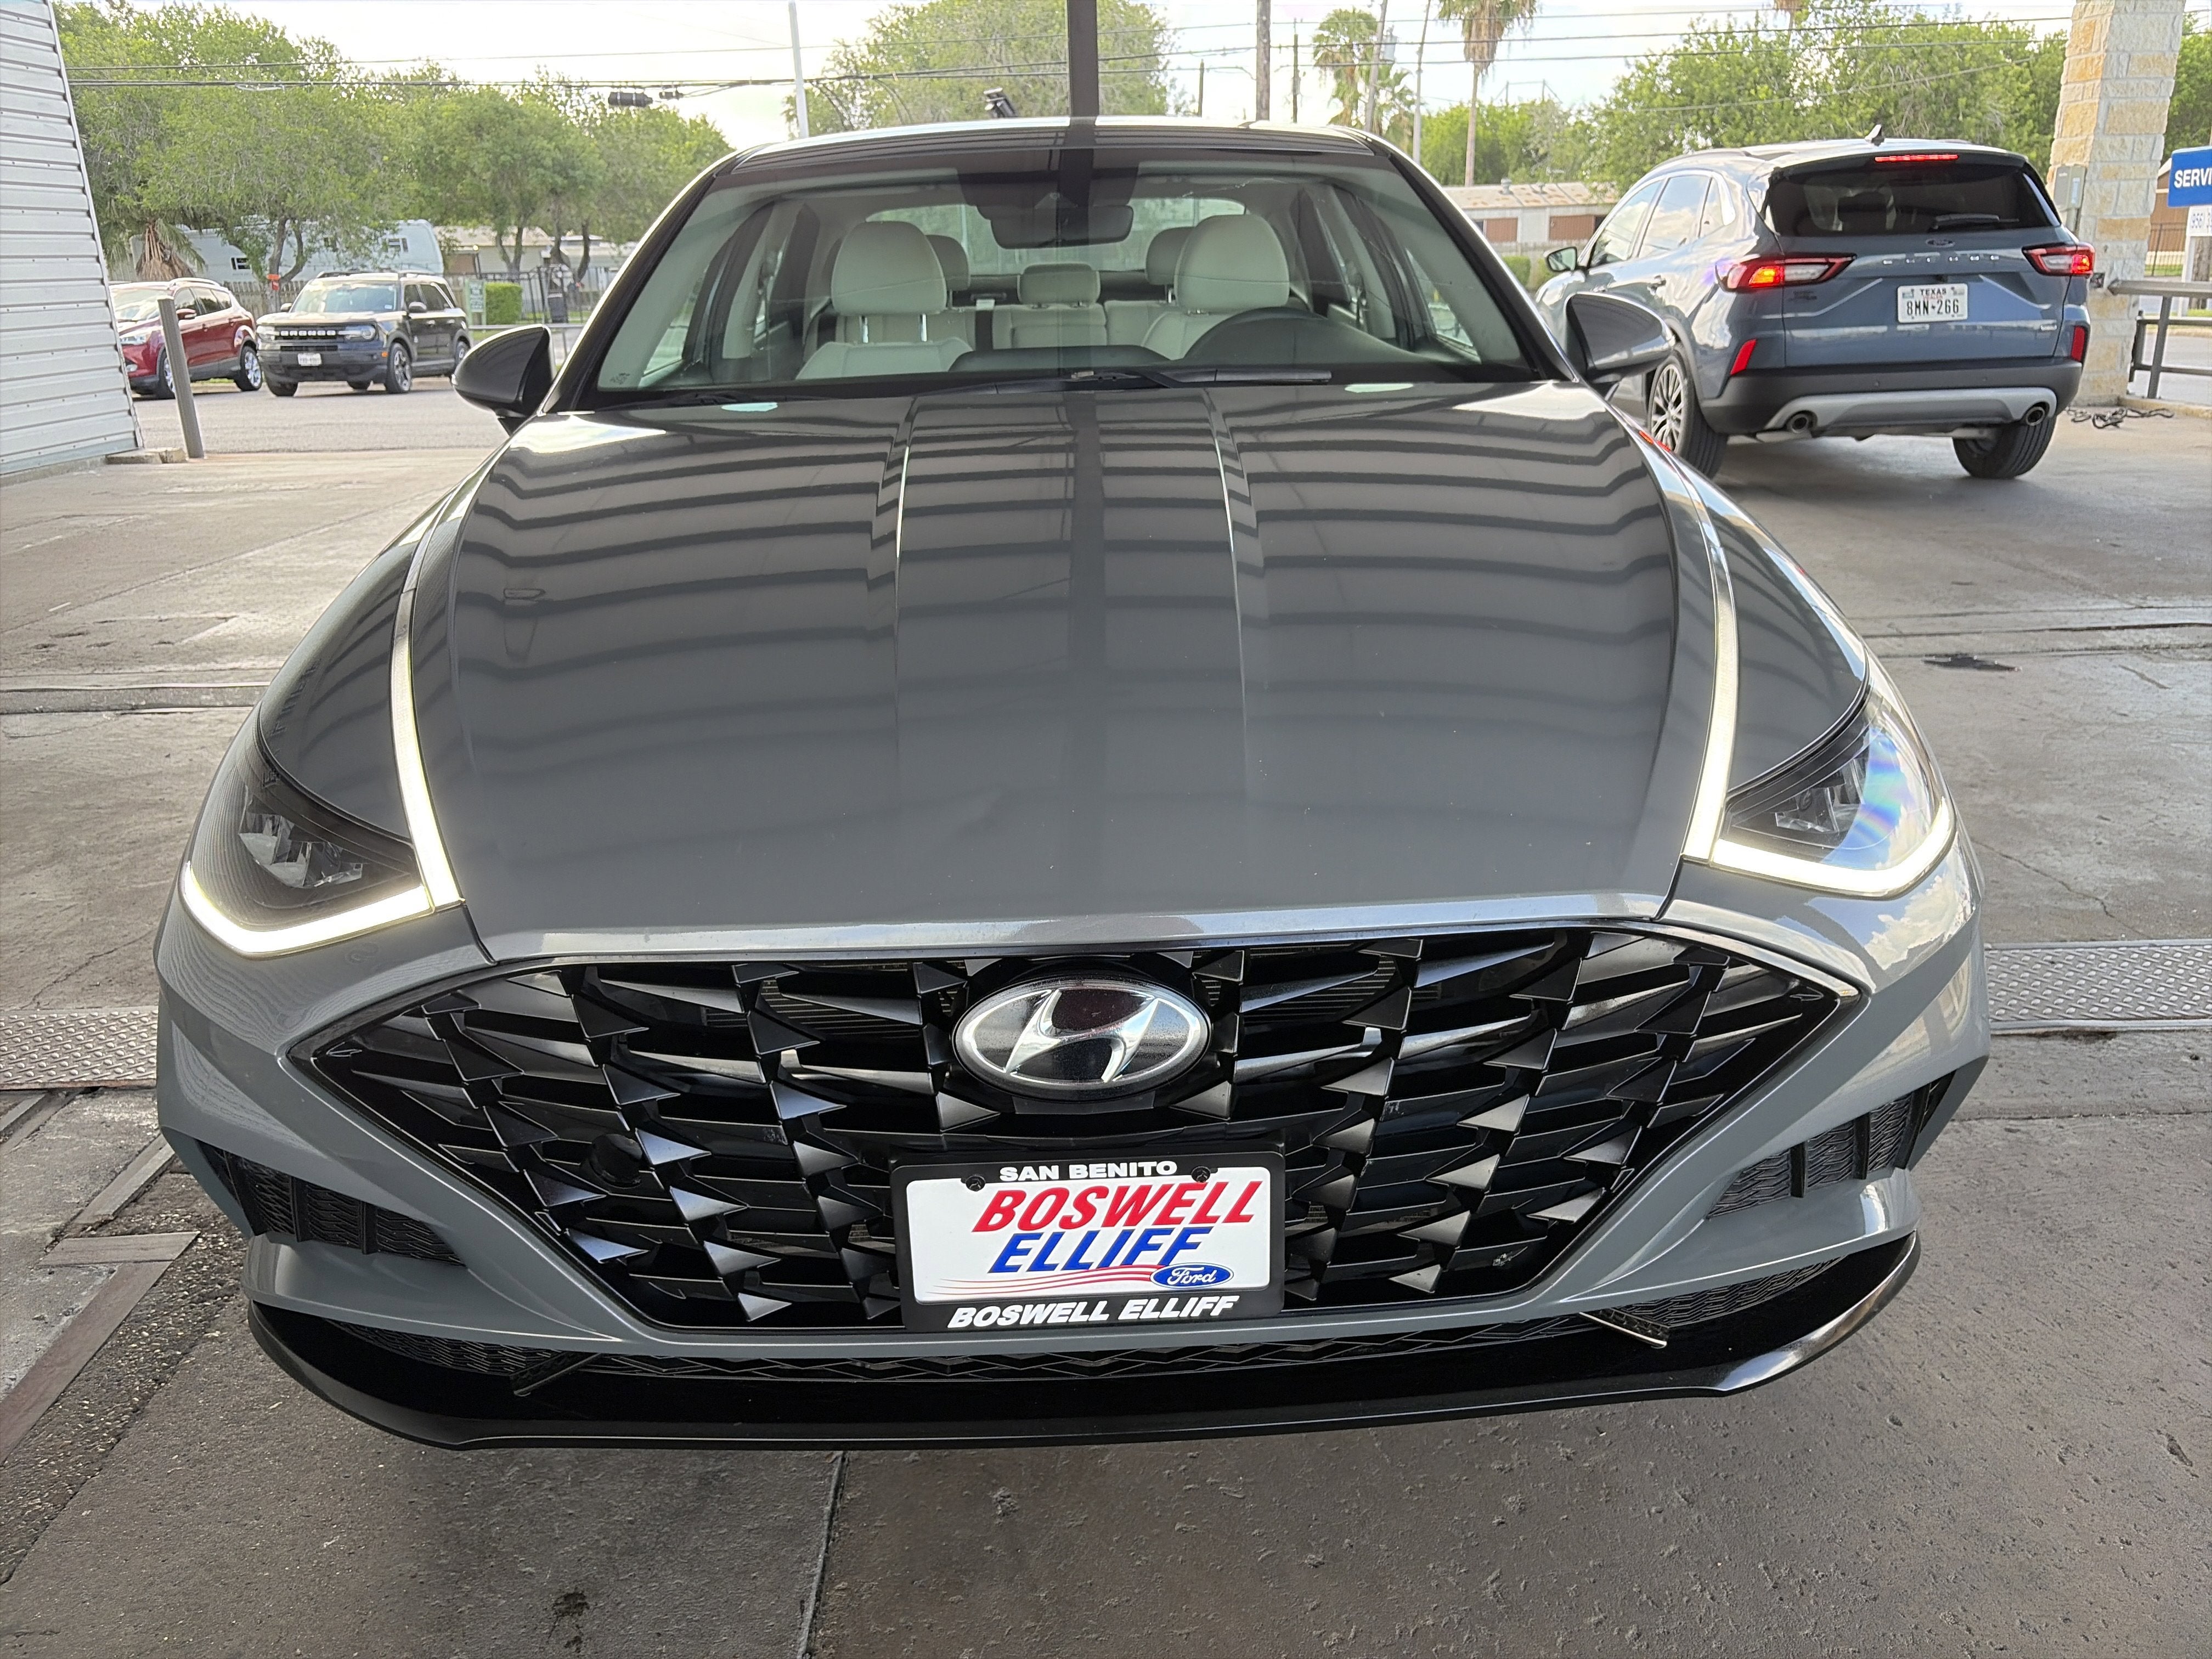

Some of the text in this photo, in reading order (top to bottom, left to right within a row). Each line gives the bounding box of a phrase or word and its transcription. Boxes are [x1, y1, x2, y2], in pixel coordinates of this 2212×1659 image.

[2174, 167, 2212, 188] SERVI
[1000, 1161, 1178, 1181] SAN BENITO
[972, 1181, 1262, 1232] BOSWELL
[988, 1227, 1213, 1273] ELLIFF
[1166, 1266, 1218, 1285] Ford
[947, 1295, 1240, 1329] BOSWELL ELLIFF
